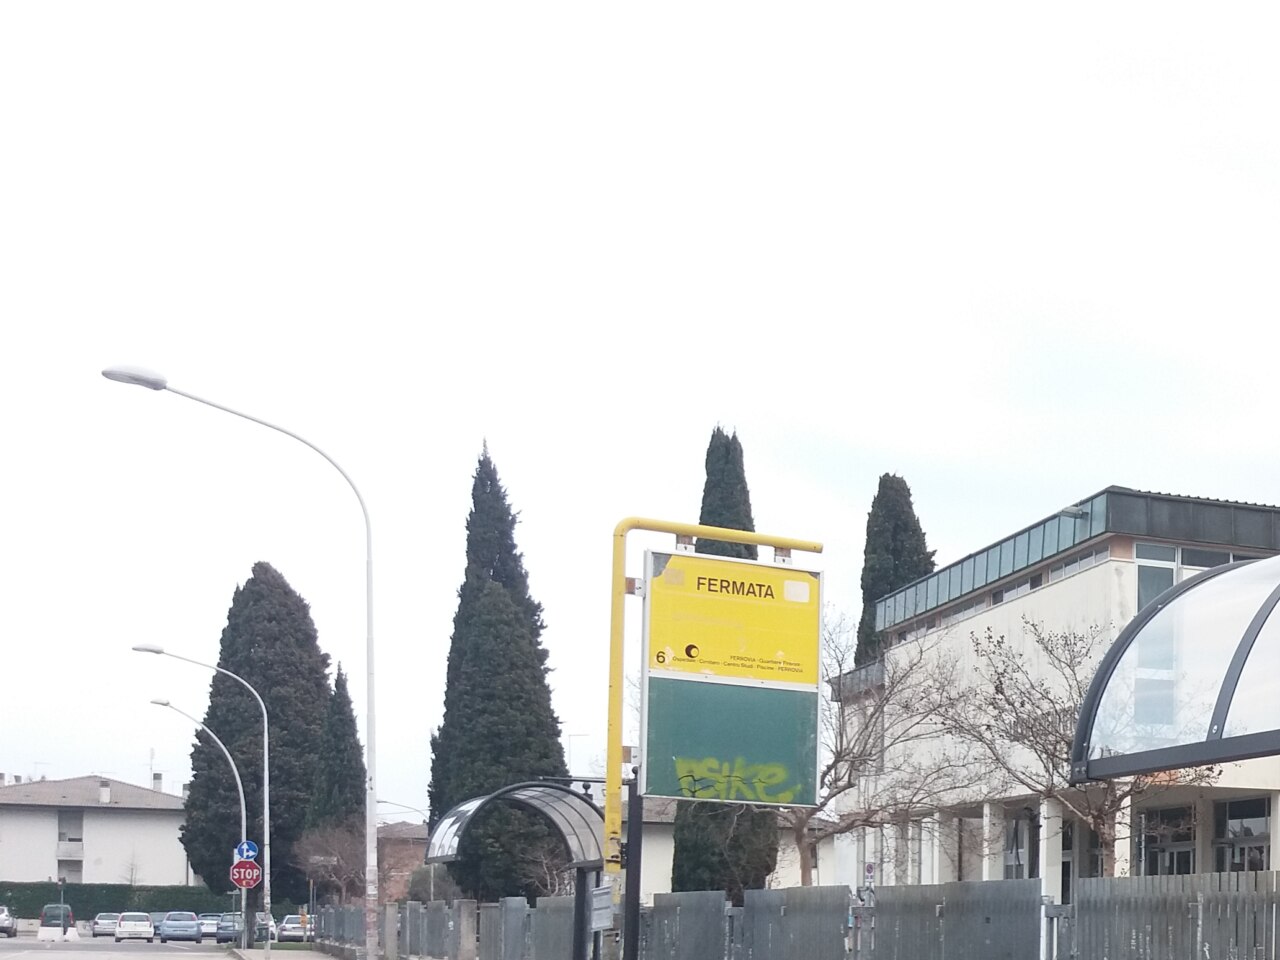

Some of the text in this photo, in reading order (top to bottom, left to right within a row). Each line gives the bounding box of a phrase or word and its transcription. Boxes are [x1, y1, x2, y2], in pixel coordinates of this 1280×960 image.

[697, 576, 775, 600] FERMATA
[656, 651, 666, 664] 6
[233, 868, 260, 879] STOP
